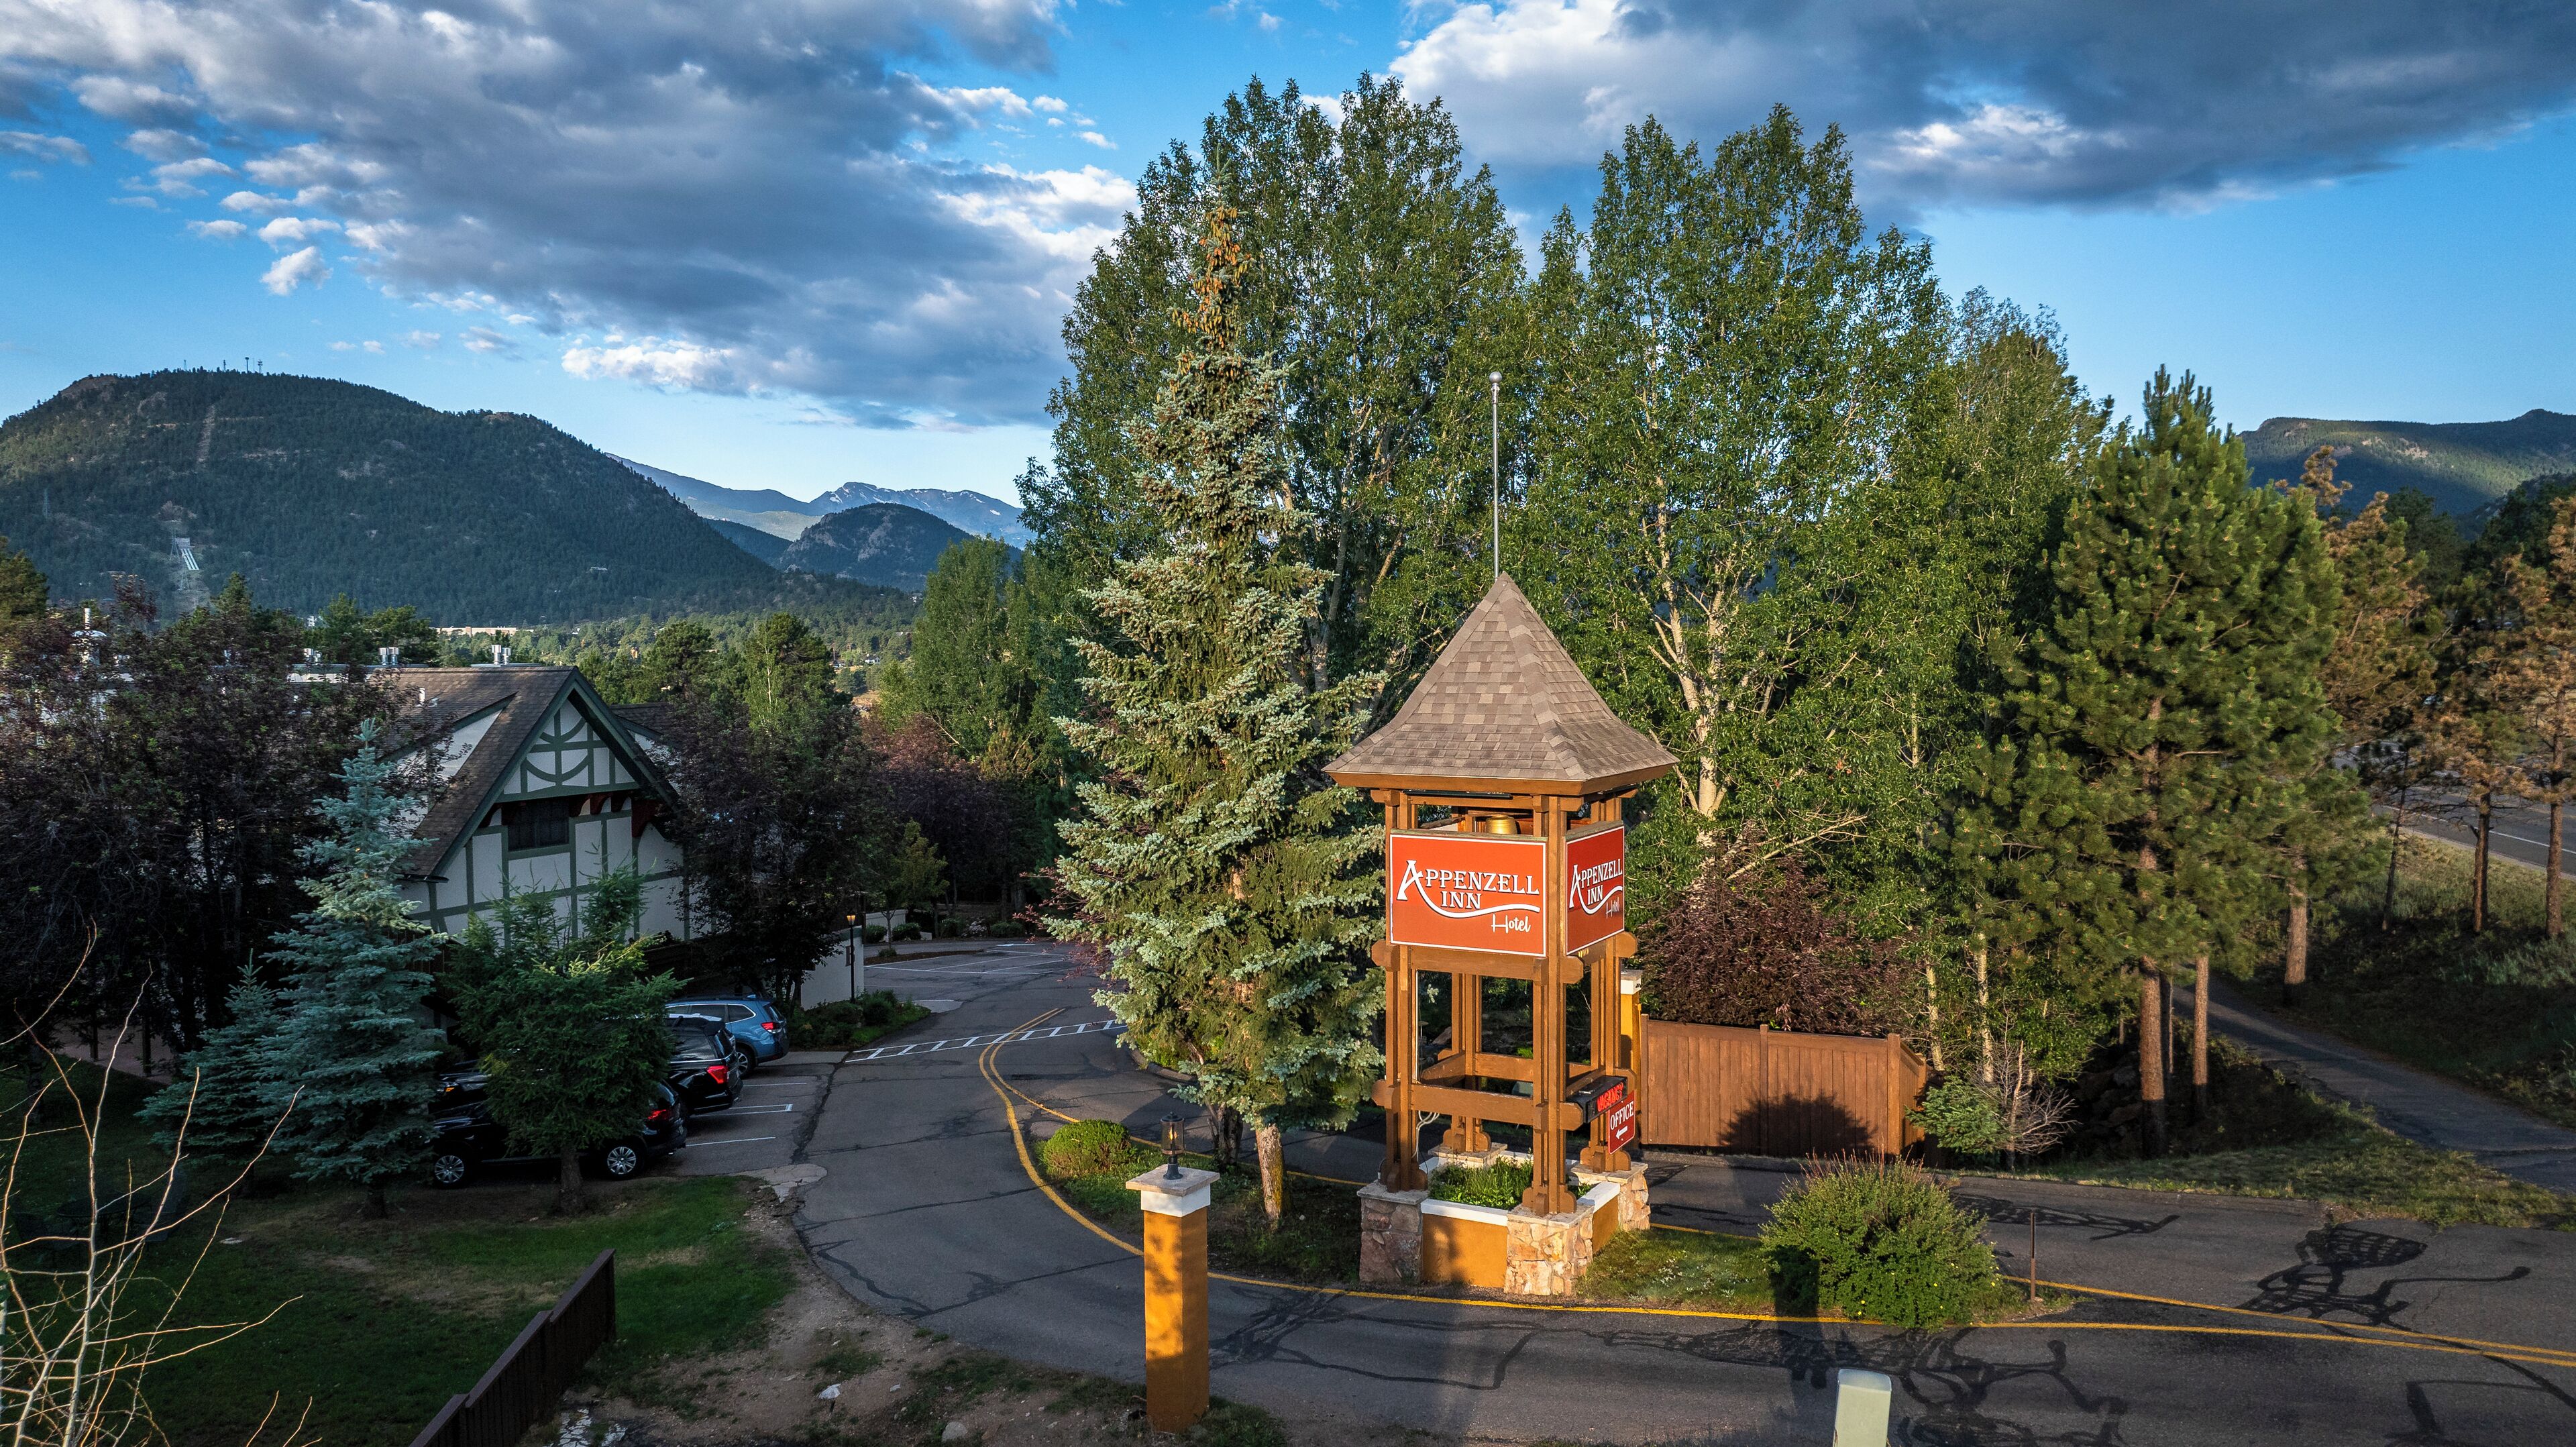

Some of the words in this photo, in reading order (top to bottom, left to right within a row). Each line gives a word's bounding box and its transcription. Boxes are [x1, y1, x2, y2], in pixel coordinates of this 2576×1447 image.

[1397, 859, 1540, 901] APPENZELL
[1569, 859, 1623, 908] APPENZELL
[1441, 890, 1482, 910] INN
[1587, 885, 1603, 906] INN
[1605, 896, 1620, 919] Hotel
[1491, 914, 1532, 934] Hotel
[1597, 1081, 1624, 1112] VACANCY
[1610, 1101, 1634, 1130] OFFICE
